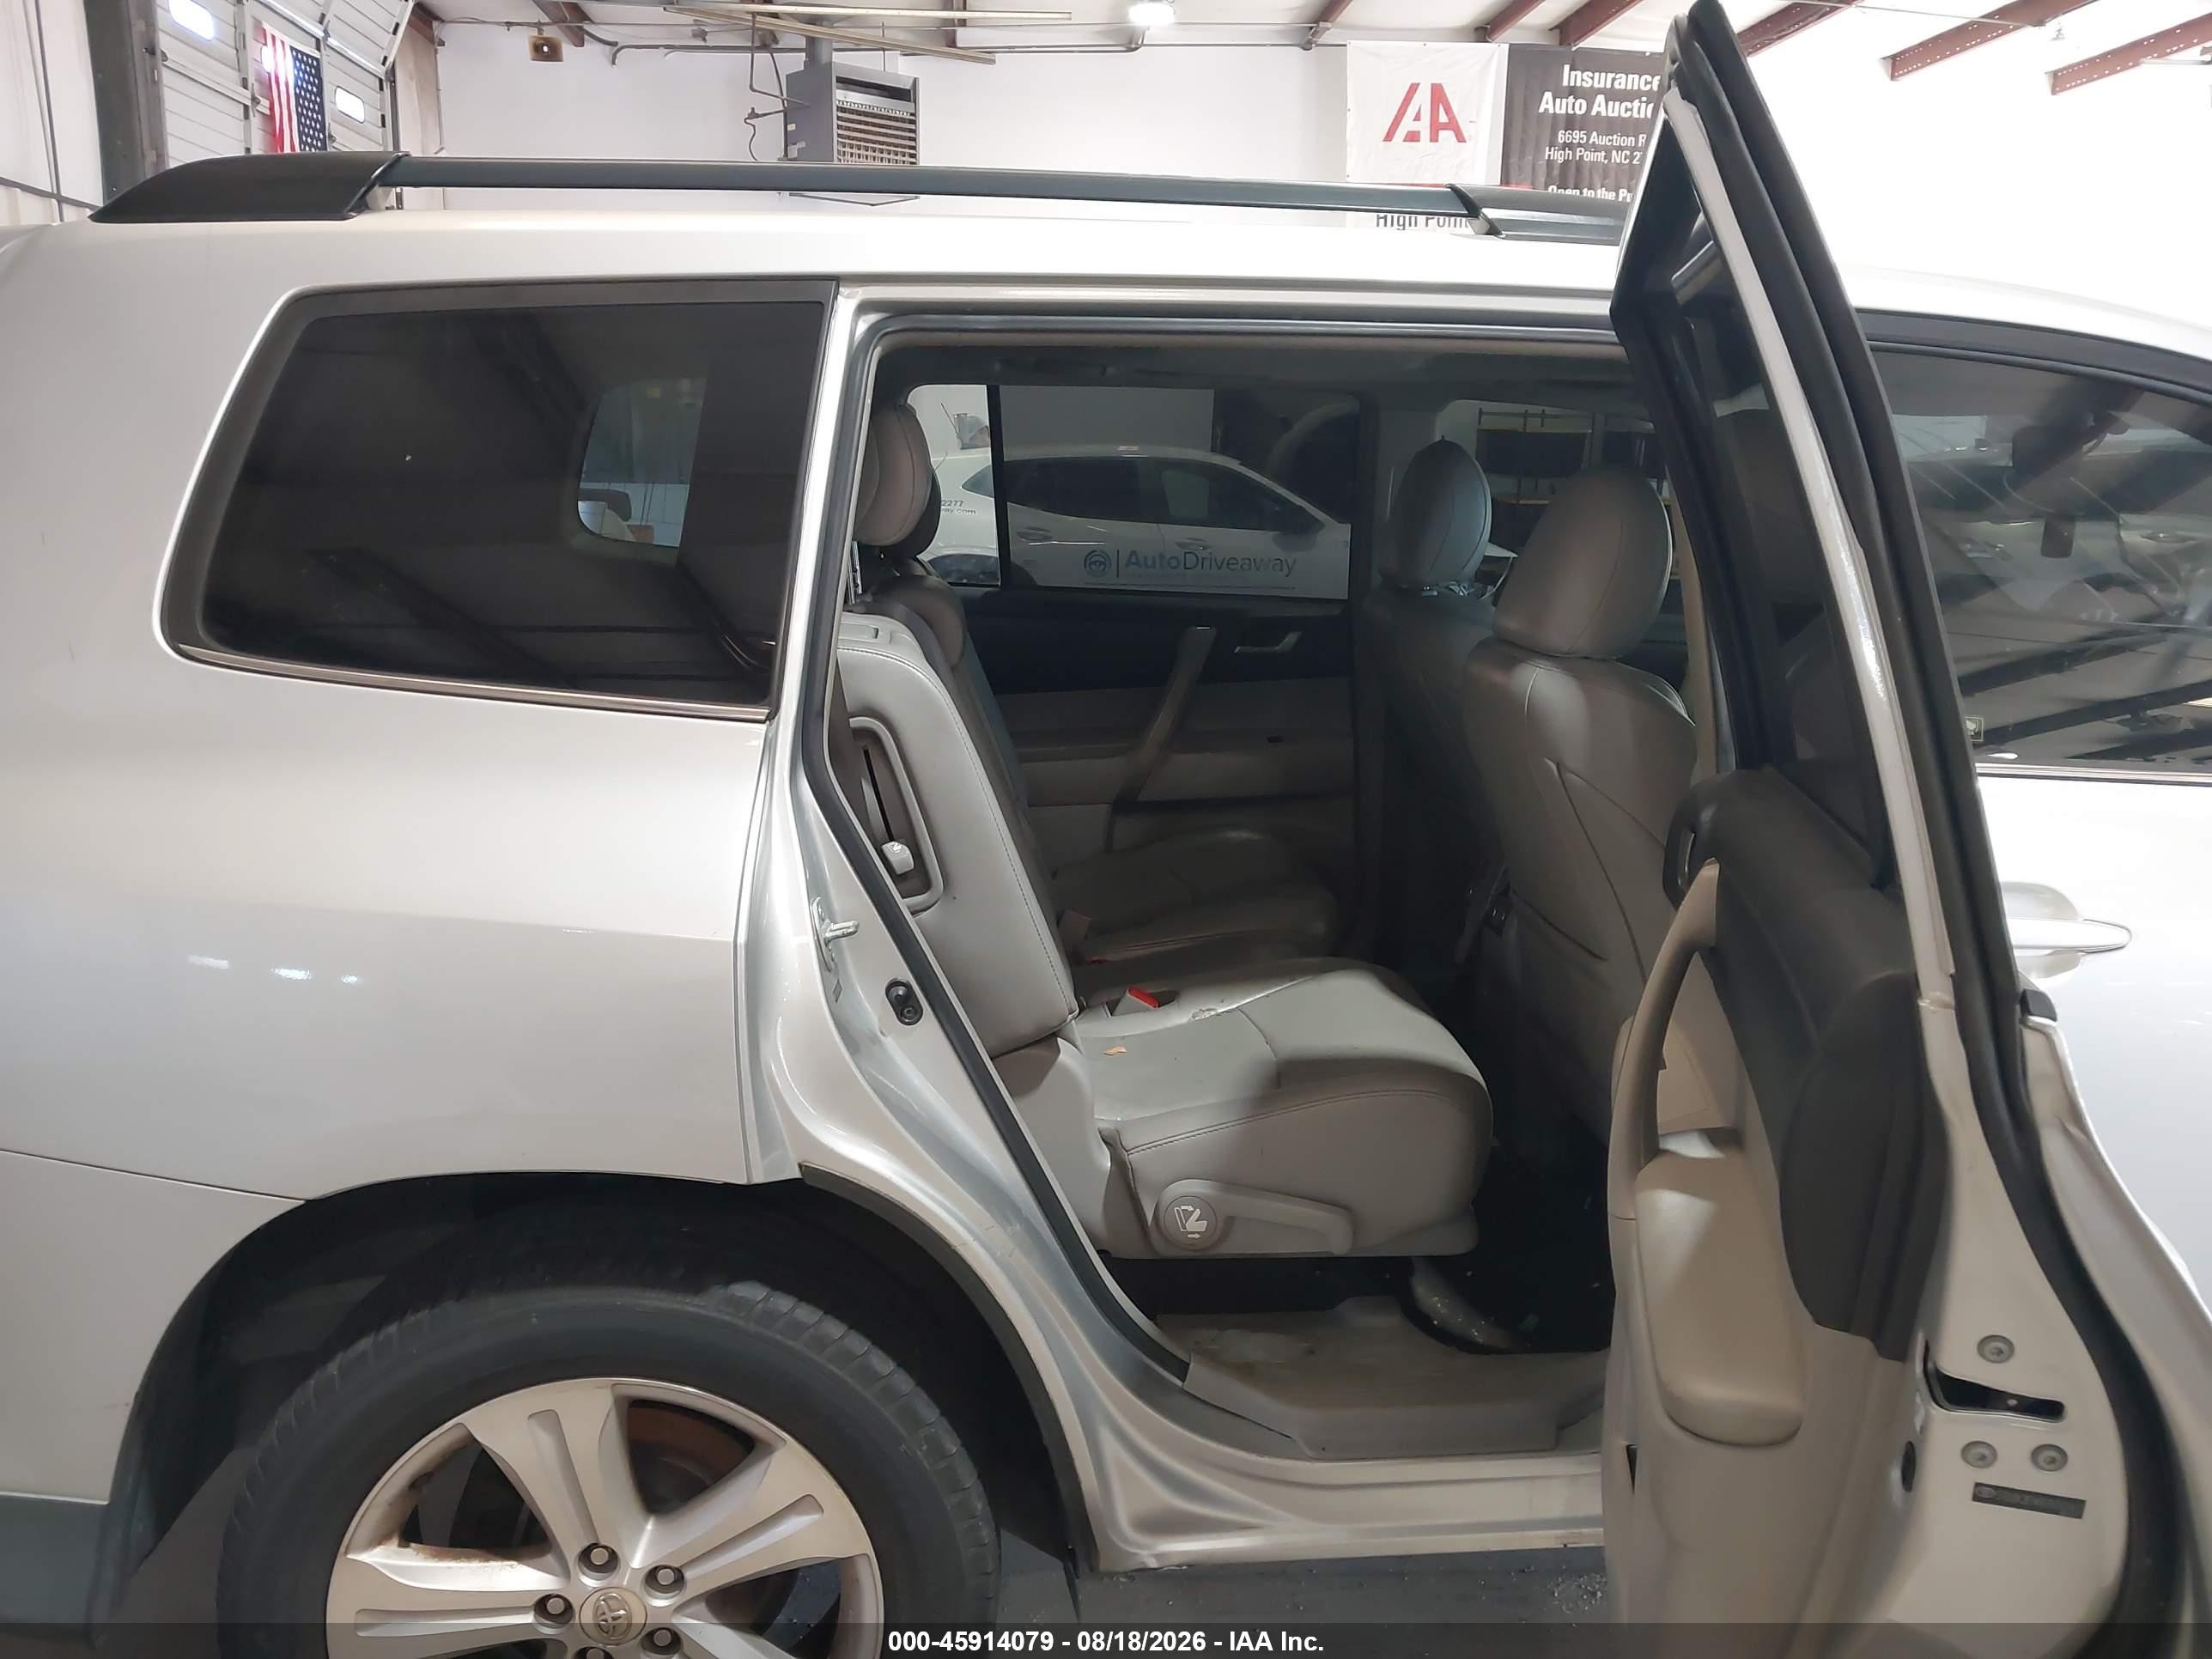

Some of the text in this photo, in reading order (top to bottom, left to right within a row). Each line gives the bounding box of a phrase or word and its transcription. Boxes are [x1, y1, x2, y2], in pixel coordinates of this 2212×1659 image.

[1538, 91, 1588, 115] Auto
[1558, 130, 1588, 144] 6695
[1589, 131, 1635, 148] Auction
[1545, 146, 1643, 165] High Point, NC 2
[1597, 186, 1615, 200] the
[1124, 550, 1297, 578] AutoDriveaway
